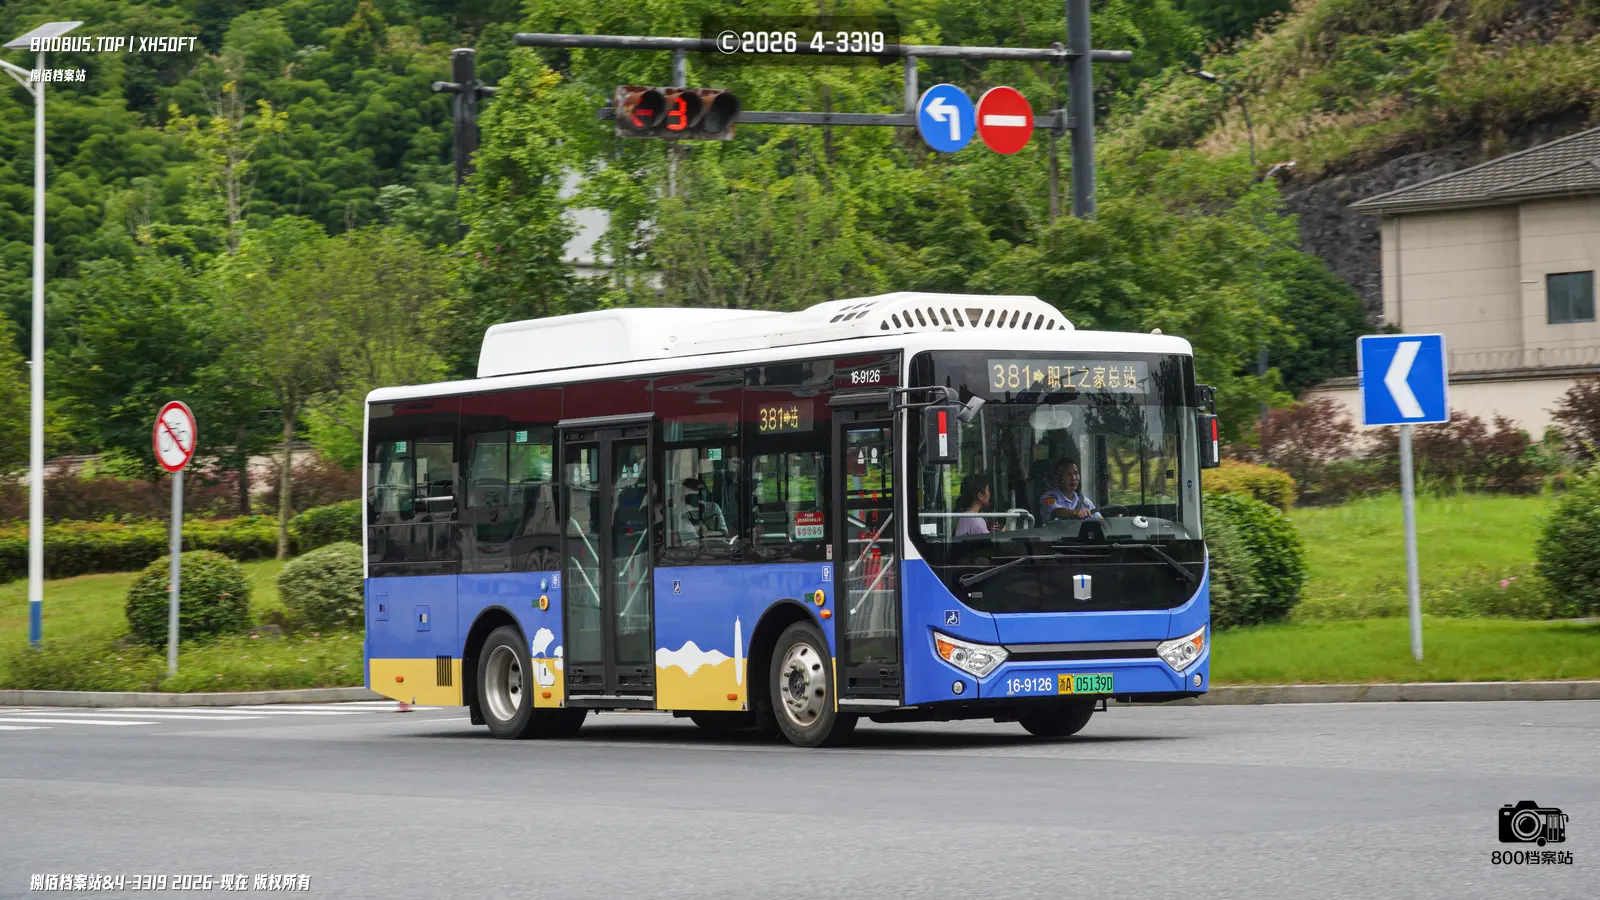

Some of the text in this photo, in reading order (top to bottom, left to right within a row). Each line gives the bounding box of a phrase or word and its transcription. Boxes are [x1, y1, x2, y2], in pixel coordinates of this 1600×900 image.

[850, 369, 881, 385] 16-9126
[993, 364, 1137, 389] 381 职工之家总站
[760, 406, 783, 431] 381
[1007, 677, 1053, 693] 16-9126
[1076, 676, 1113, 692] 05139D
